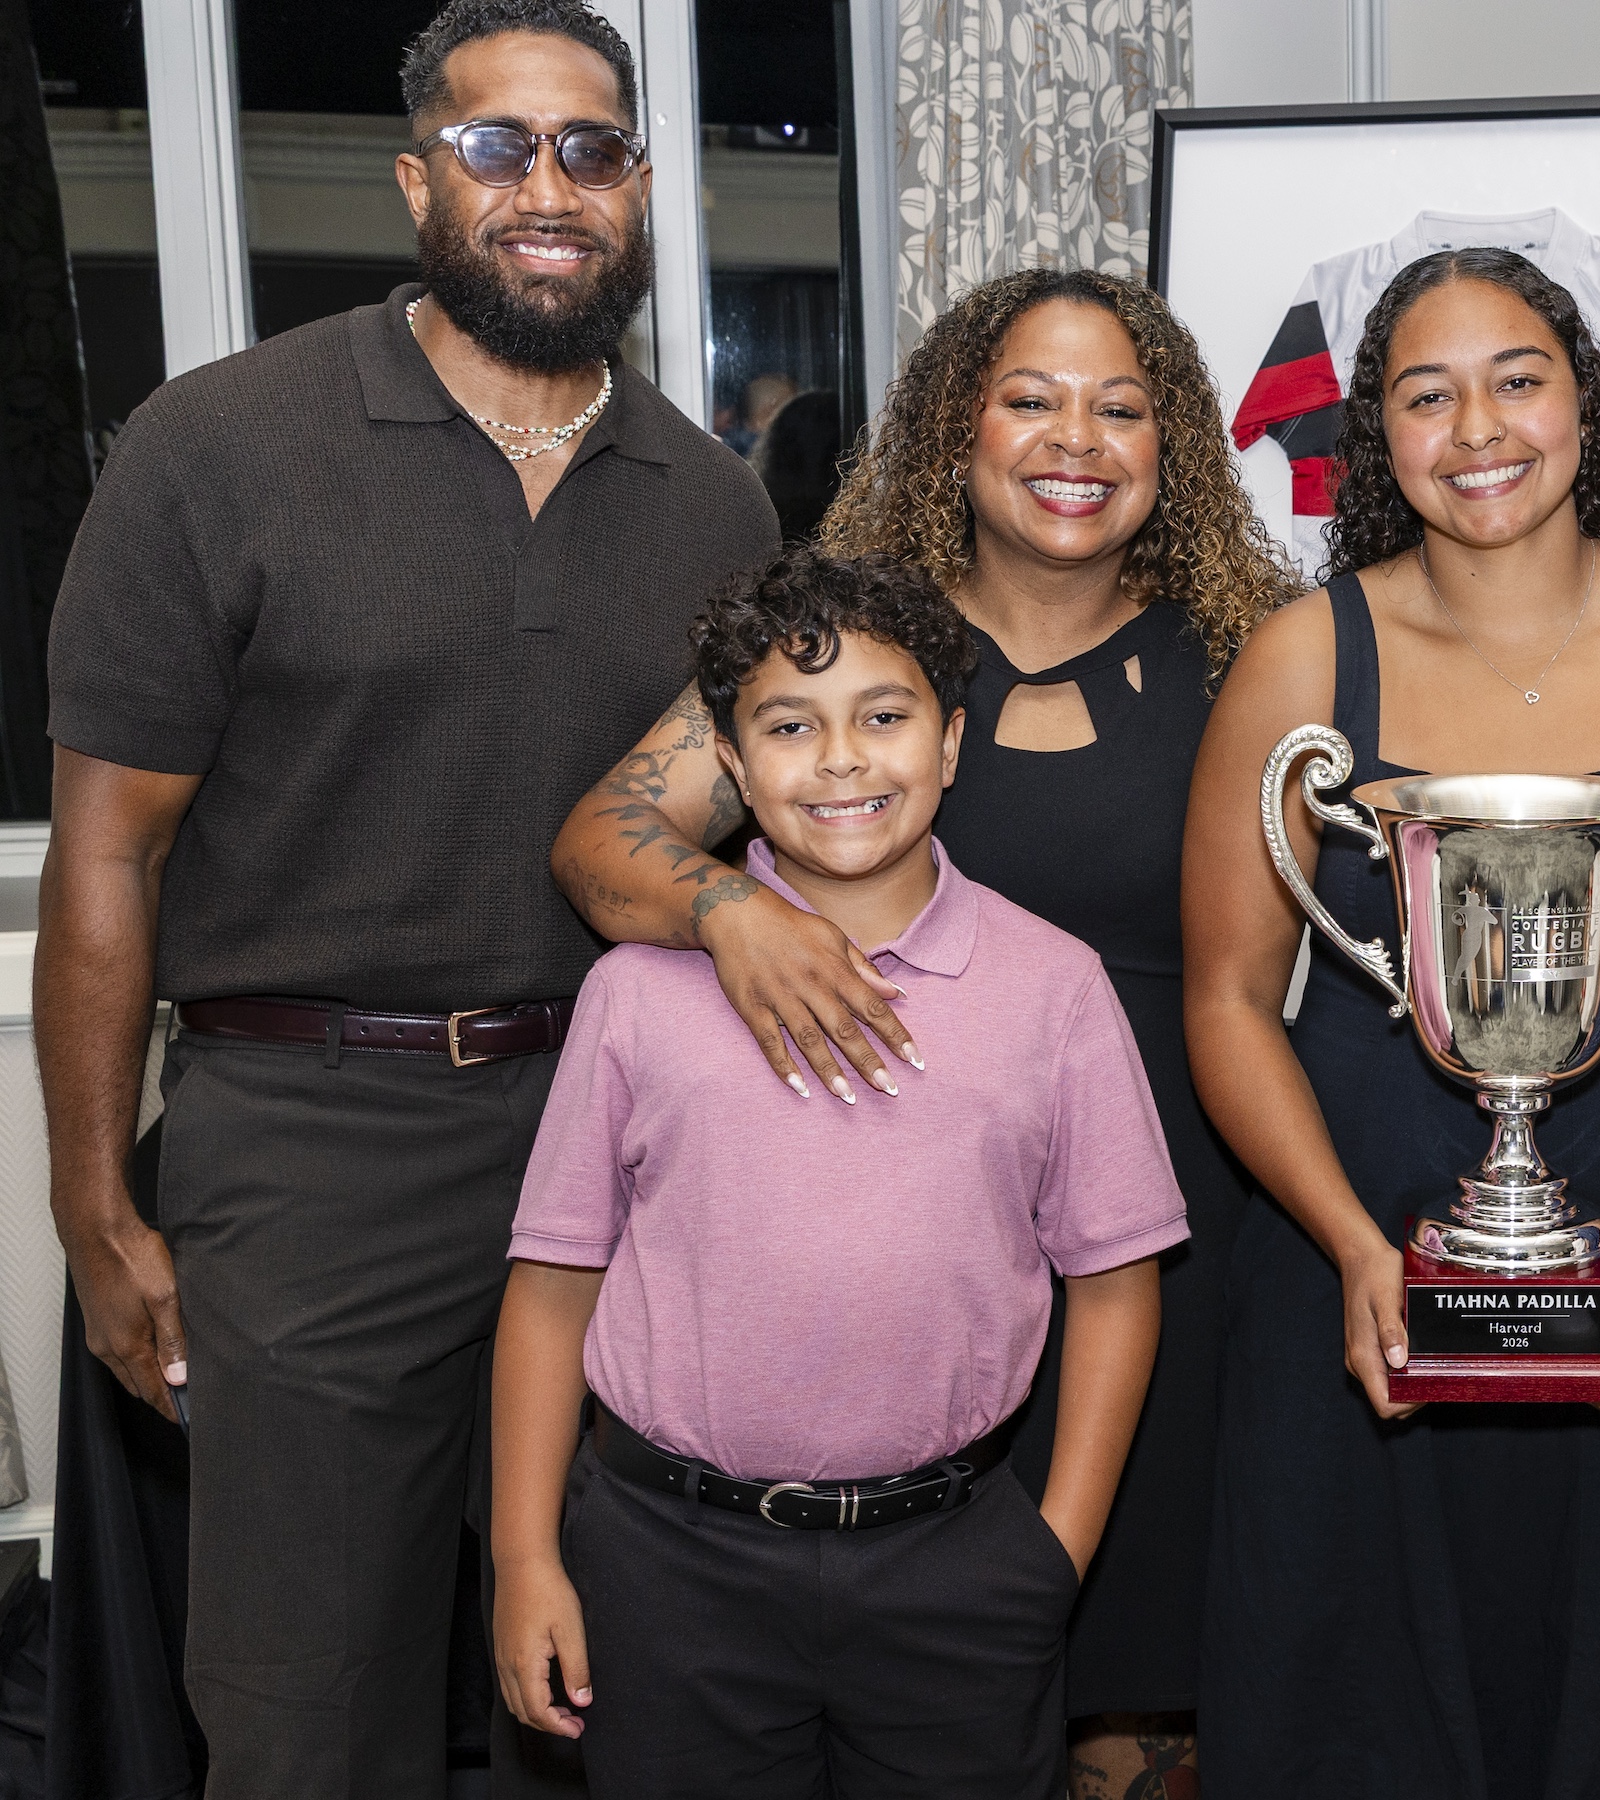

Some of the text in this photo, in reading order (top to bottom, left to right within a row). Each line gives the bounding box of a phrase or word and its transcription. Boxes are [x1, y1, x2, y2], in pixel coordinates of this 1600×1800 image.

[1512, 917, 1600, 931] COLLEGIATE
[1512, 930, 1598, 951] RUGBY
[1512, 957, 1545, 967] PLAYER
[1546, 957, 1559, 966] OF
[1561, 956, 1576, 966] THE
[1434, 1294, 1597, 1309] TIAHNA PADILLA
[1489, 1322, 1542, 1334] Harvard
[1502, 1338, 1529, 1348] 2026
